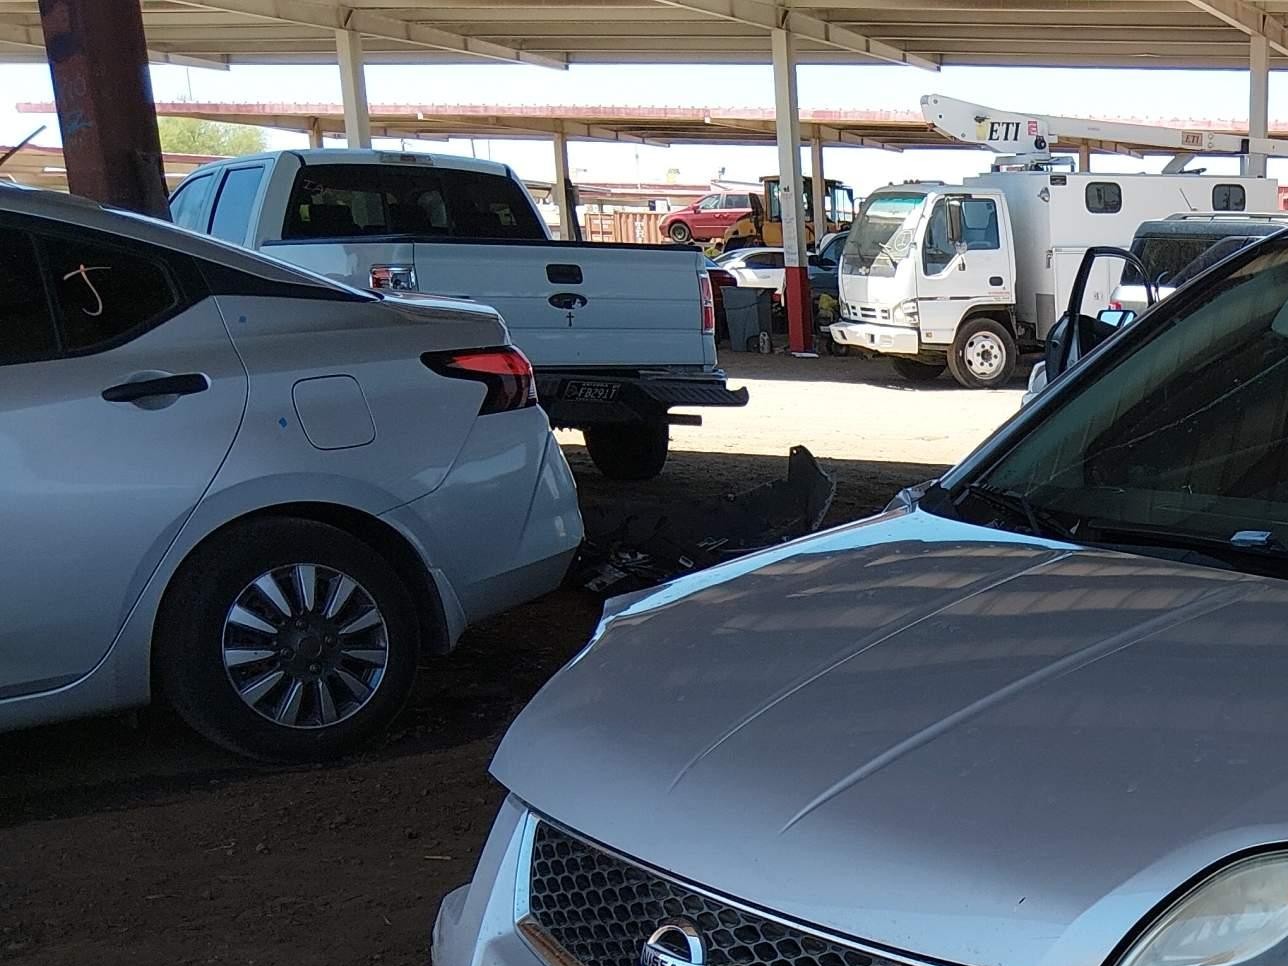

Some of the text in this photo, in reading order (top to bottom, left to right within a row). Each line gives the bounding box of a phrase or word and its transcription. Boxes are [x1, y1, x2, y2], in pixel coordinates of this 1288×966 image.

[988, 120, 1021, 142] ETI
[1185, 134, 1200, 145] ETI
[63, 264, 112, 316] J
